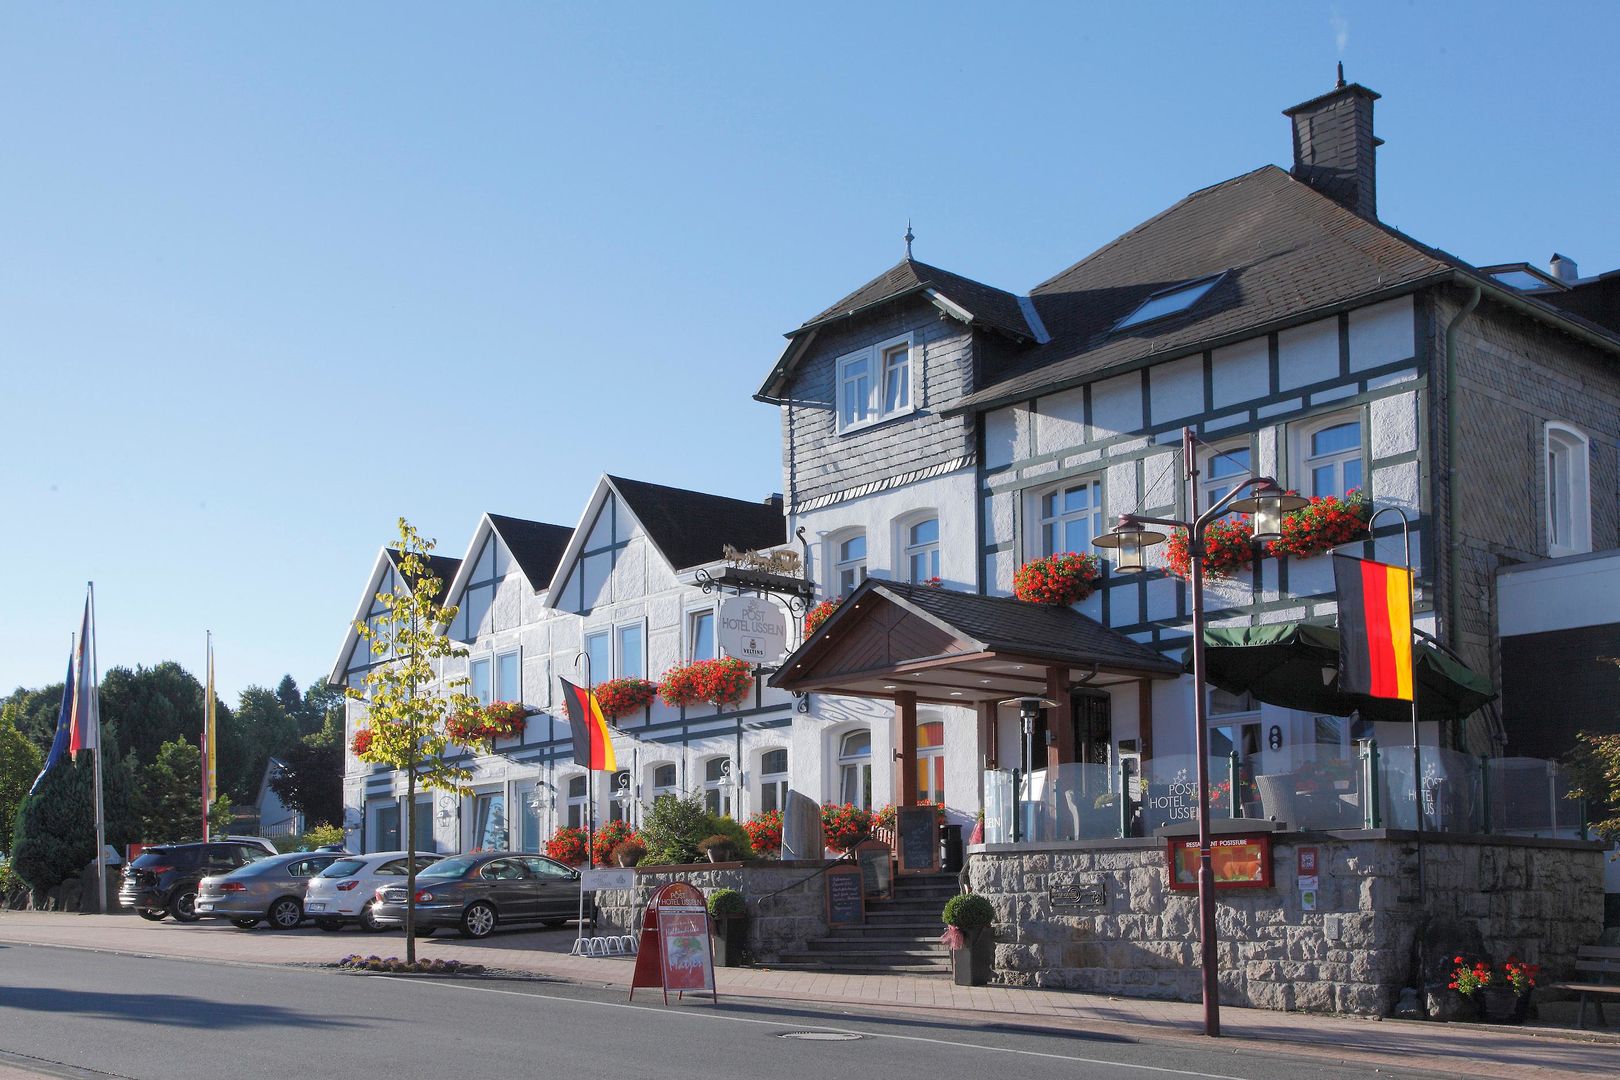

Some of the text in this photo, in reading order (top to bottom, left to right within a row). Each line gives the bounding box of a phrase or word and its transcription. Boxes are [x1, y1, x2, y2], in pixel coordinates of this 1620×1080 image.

[742, 609, 766, 621] POST
[722, 618, 783, 637] HOTEL USSELN
[1169, 782, 1198, 796] POST
[1408, 789, 1433, 802] HTEL
[1149, 796, 1185, 809] HOTEL
